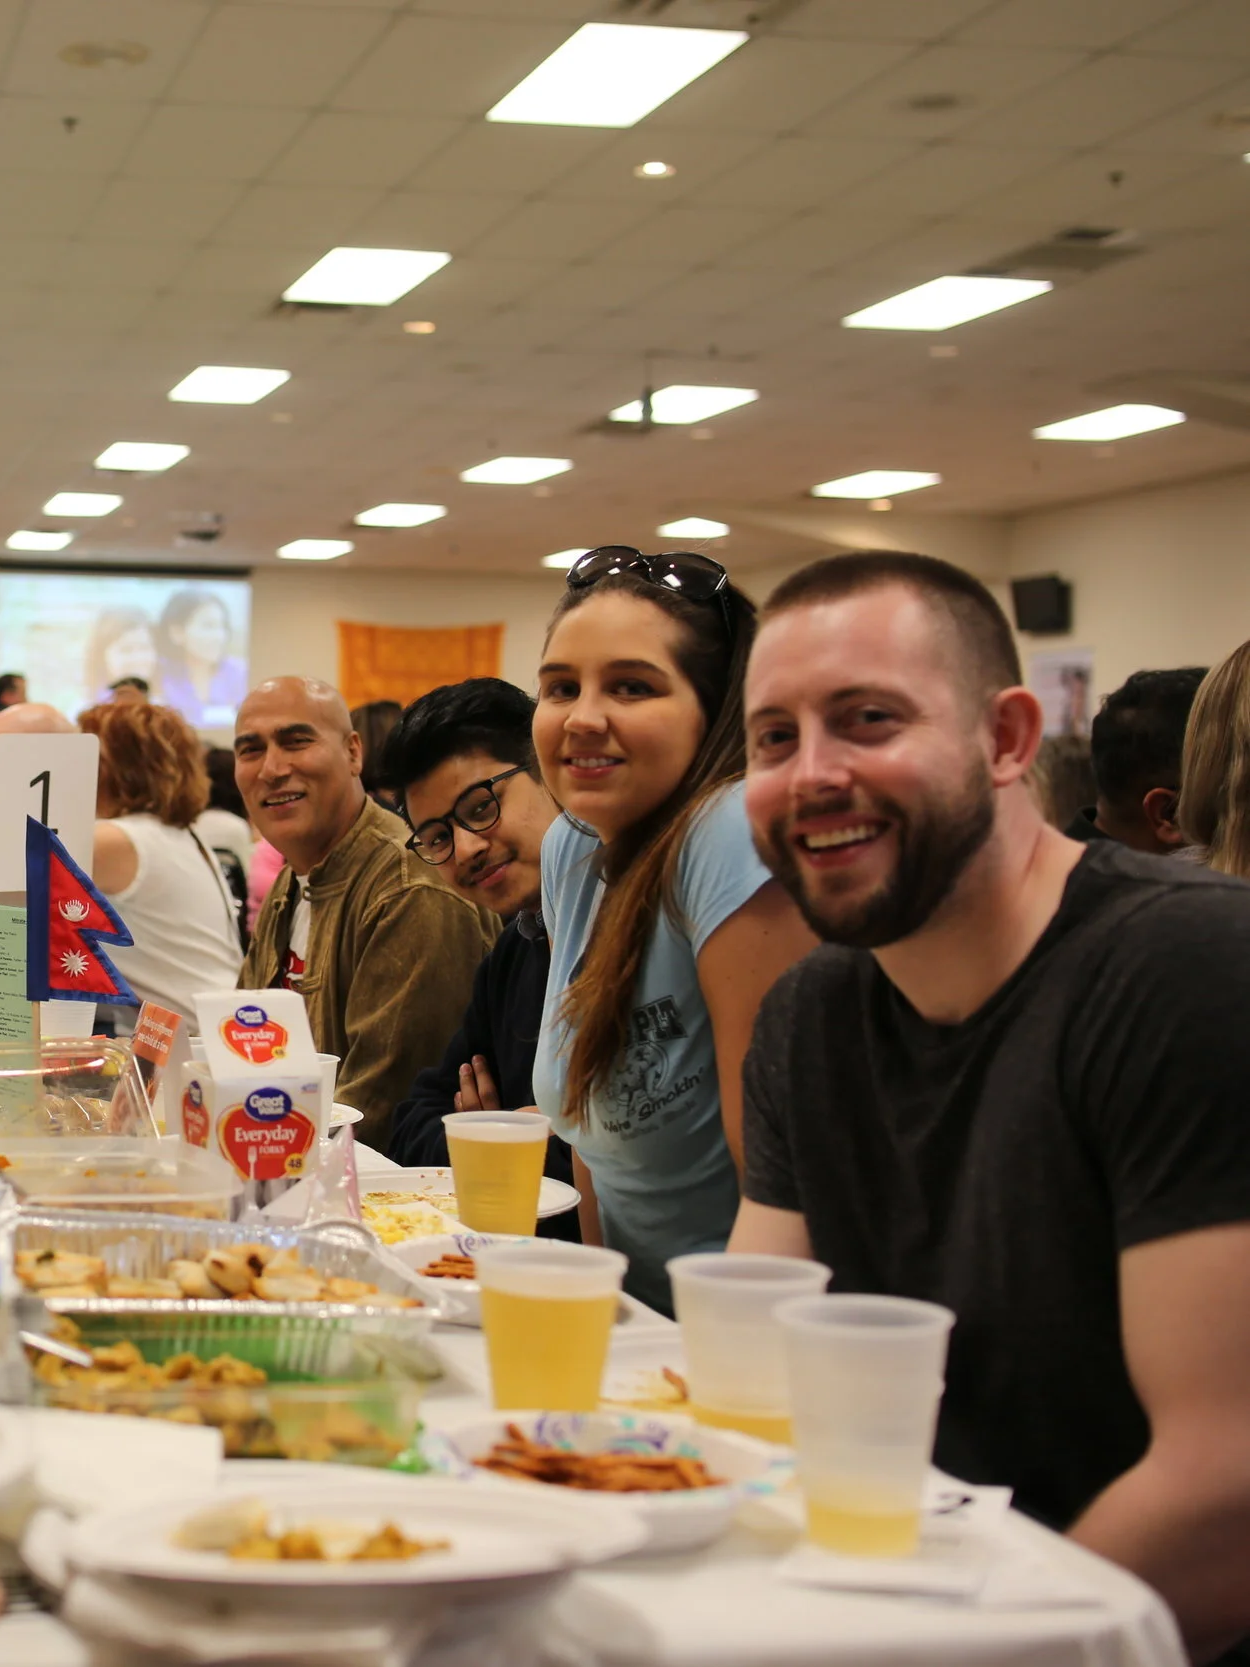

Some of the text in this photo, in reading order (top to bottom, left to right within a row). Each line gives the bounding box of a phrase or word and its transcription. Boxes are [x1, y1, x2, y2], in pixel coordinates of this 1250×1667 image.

[30, 770, 58, 834] 1
[231, 1028, 276, 1041] Everyday
[249, 1094, 284, 1109] Great
[258, 1106, 285, 1116] Value
[234, 1124, 298, 1144] Everyday
[259, 1145, 285, 1154] FORKS
[288, 1159, 302, 1168] 48
